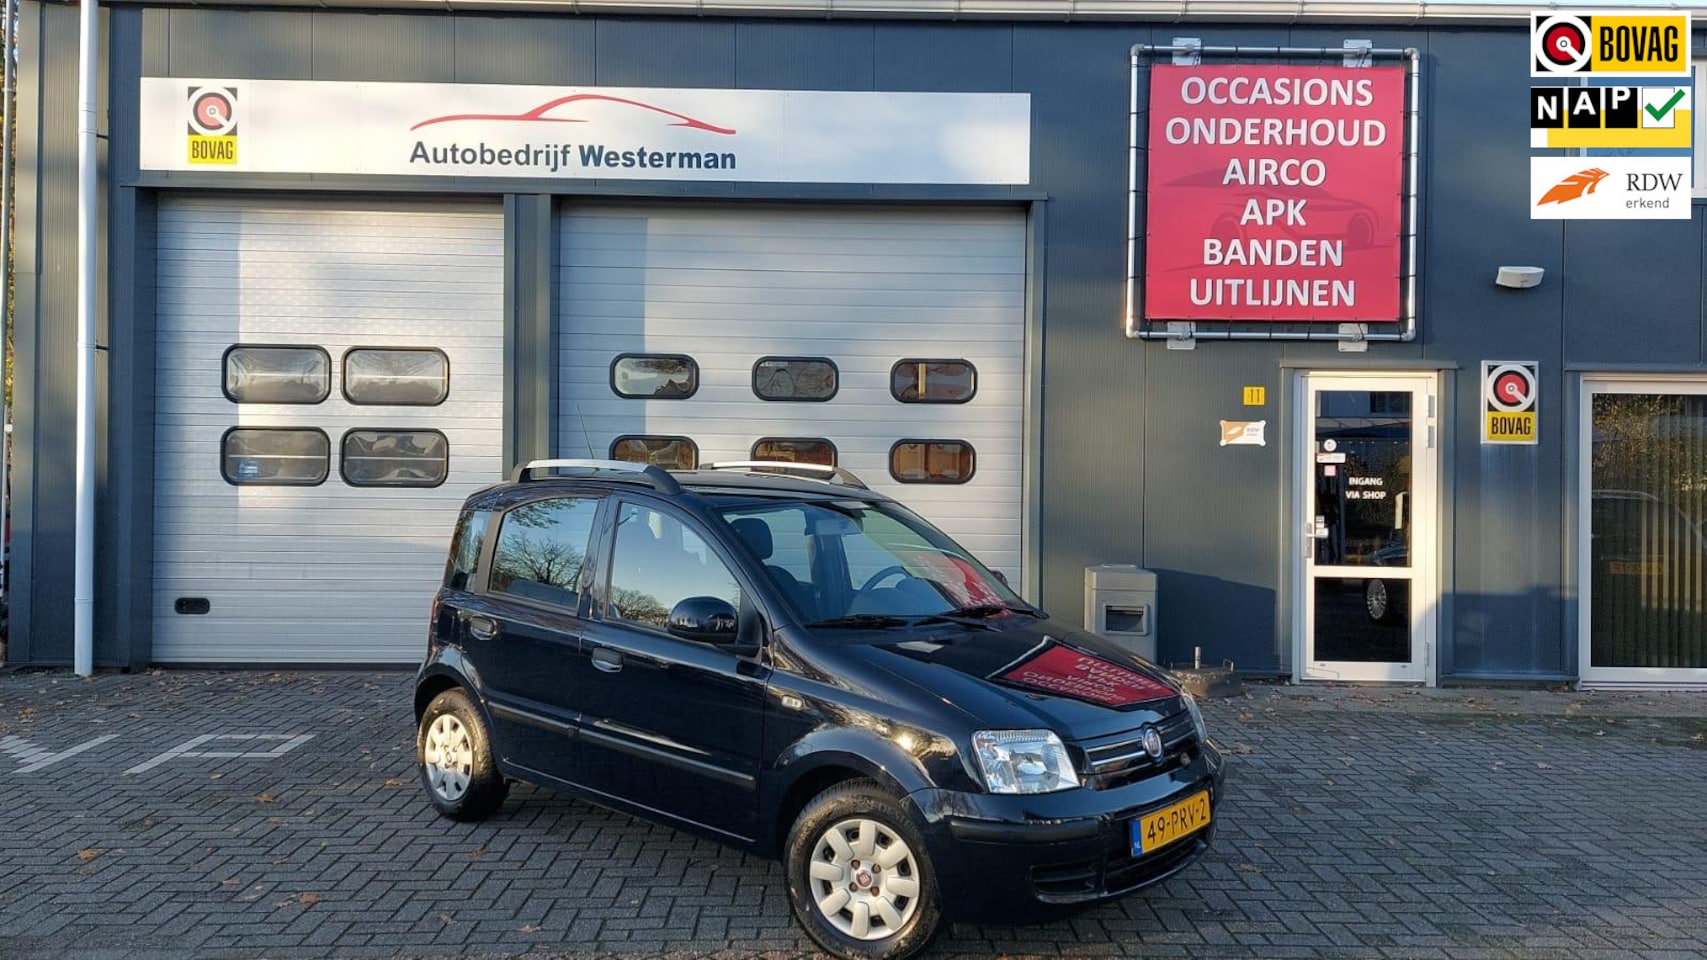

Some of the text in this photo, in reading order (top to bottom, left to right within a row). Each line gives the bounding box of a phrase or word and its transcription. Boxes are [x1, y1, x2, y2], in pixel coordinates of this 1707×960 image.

[1181, 76, 1374, 107] OCCASIONS
[1165, 117, 1387, 147] ONDERHOUD
[191, 140, 234, 160] BOVAG
[409, 141, 737, 173] Autobedrijf Westerman
[1222, 158, 1327, 187] AIRCO
[1240, 199, 1308, 227] APK
[1203, 238, 1344, 268] BANDEN
[1189, 278, 1356, 307] UITLIJNEN
[1249, 388, 1260, 404] 11
[1491, 416, 1532, 436] BOVAG
[1345, 490, 1387, 500] VIA SHOP
[1348, 477, 1384, 486] INGANG
[1147, 797, 1207, 845] 49-PRV-2
